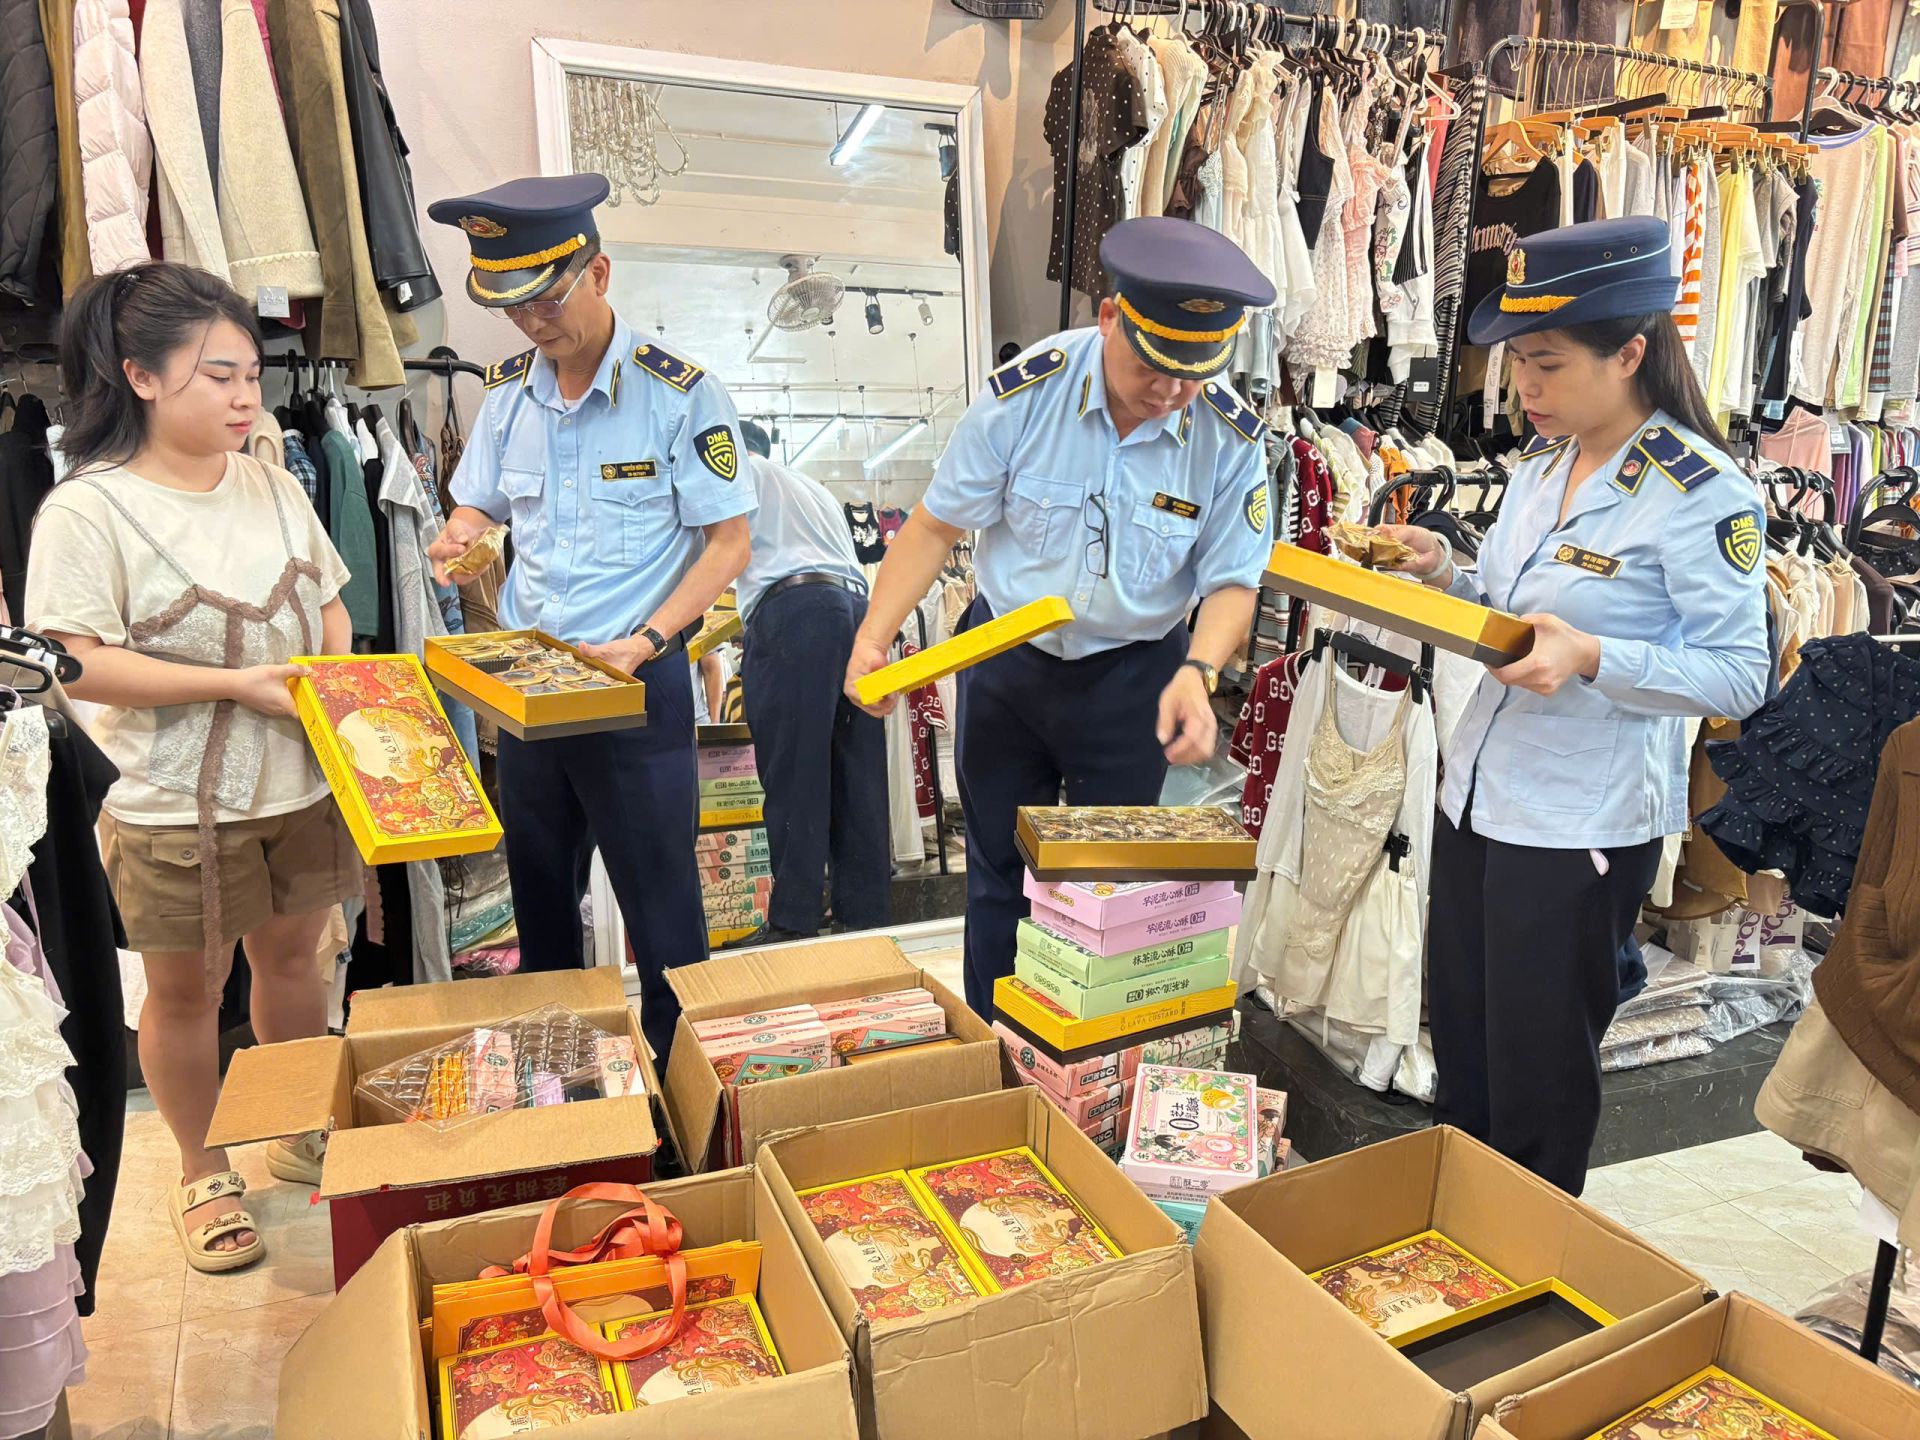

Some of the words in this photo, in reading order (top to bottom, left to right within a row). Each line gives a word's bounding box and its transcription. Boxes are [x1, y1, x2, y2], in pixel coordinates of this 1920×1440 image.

[706, 431, 729, 445] DMS
[1730, 515, 1755, 531] DMS
[1142, 887, 1184, 906] 芋泥流心酥
[1146, 914, 1189, 934] 芋泥流心酥
[1132, 947, 1176, 966] 抹茶流心酥
[1148, 1009, 1179, 1025] CUSTARD
[423, 1175, 569, 1212] 轻甜无负担
